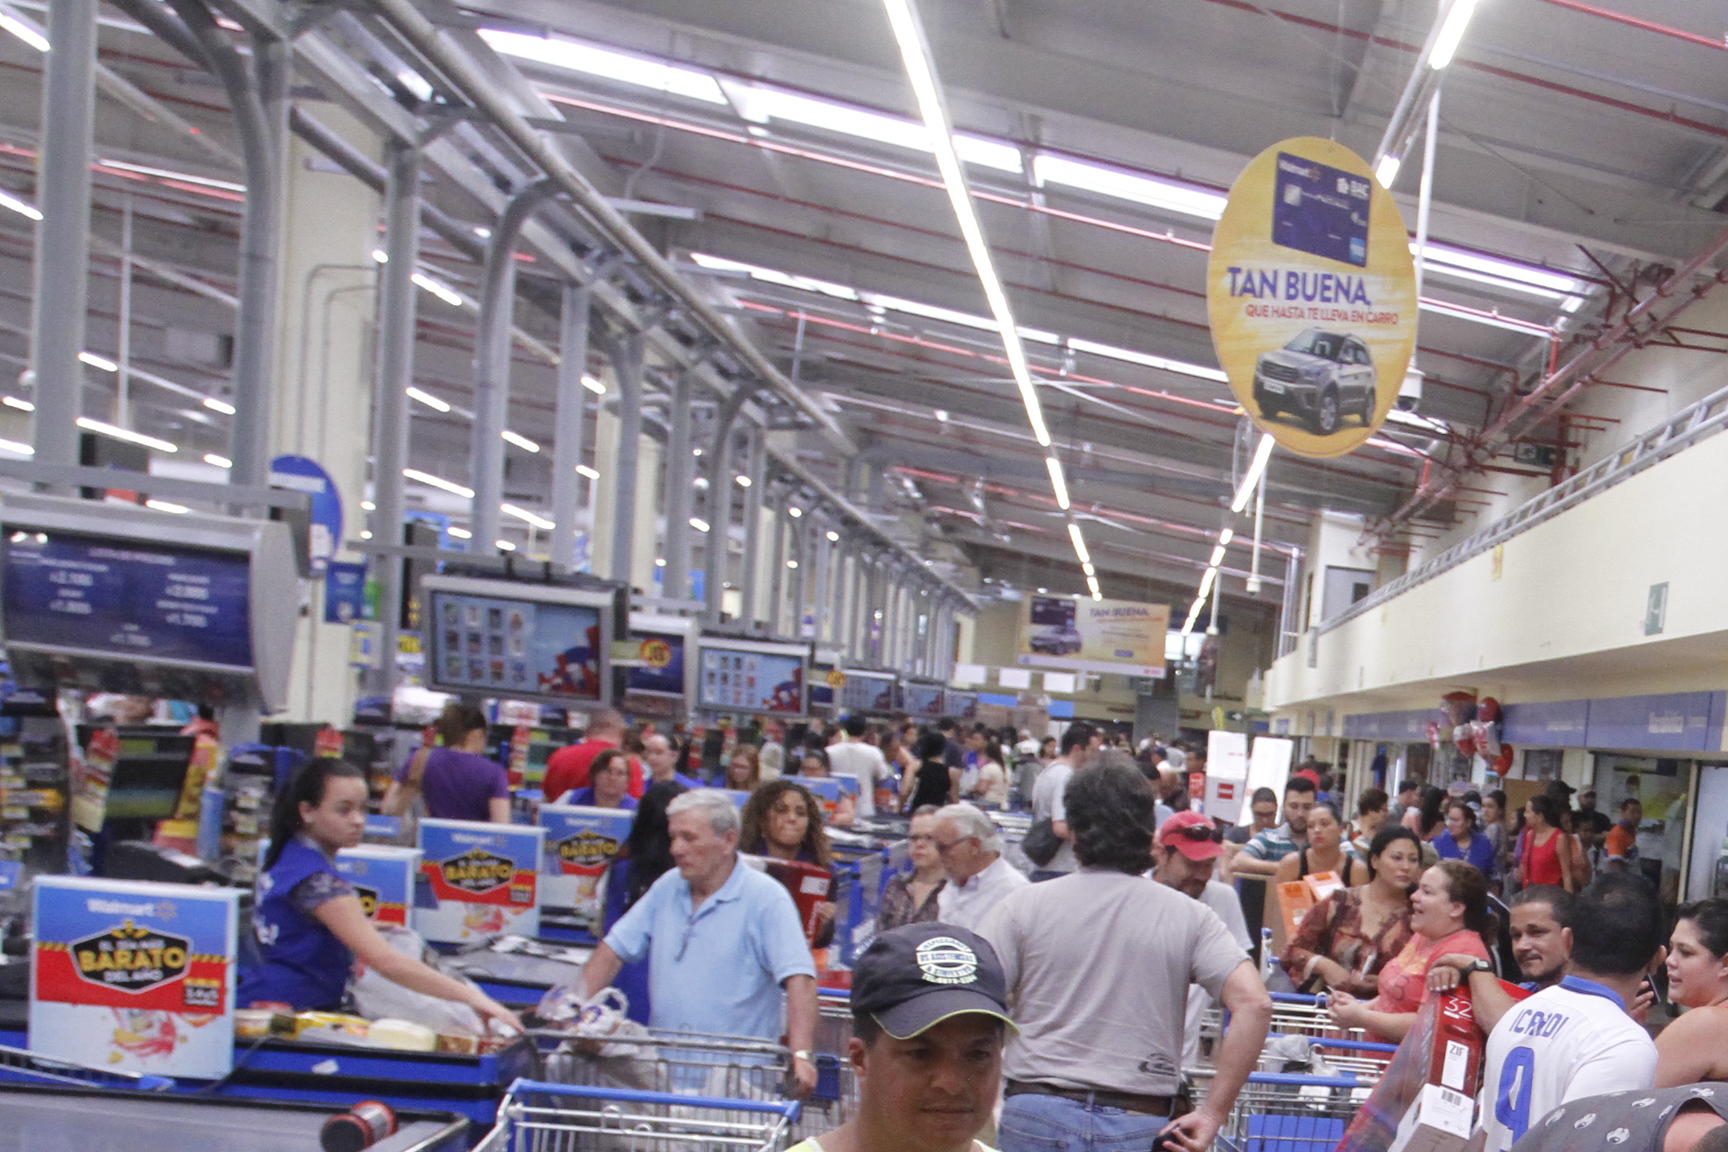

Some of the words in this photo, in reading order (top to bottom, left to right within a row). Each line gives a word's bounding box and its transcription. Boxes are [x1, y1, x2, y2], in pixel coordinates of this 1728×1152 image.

[1227, 267, 1278, 299] TAN
[1246, 304, 1270, 318] QUE
[1272, 306, 1305, 320] HASTA
[1307, 307, 1319, 321] TE
[1320, 309, 1349, 322] LLEVA
[1351, 310, 1364, 323] EN
[1365, 311, 1399, 325] CARRO
[77, 946, 188, 972] BARATO
[1444, 997, 1473, 1019] 32
